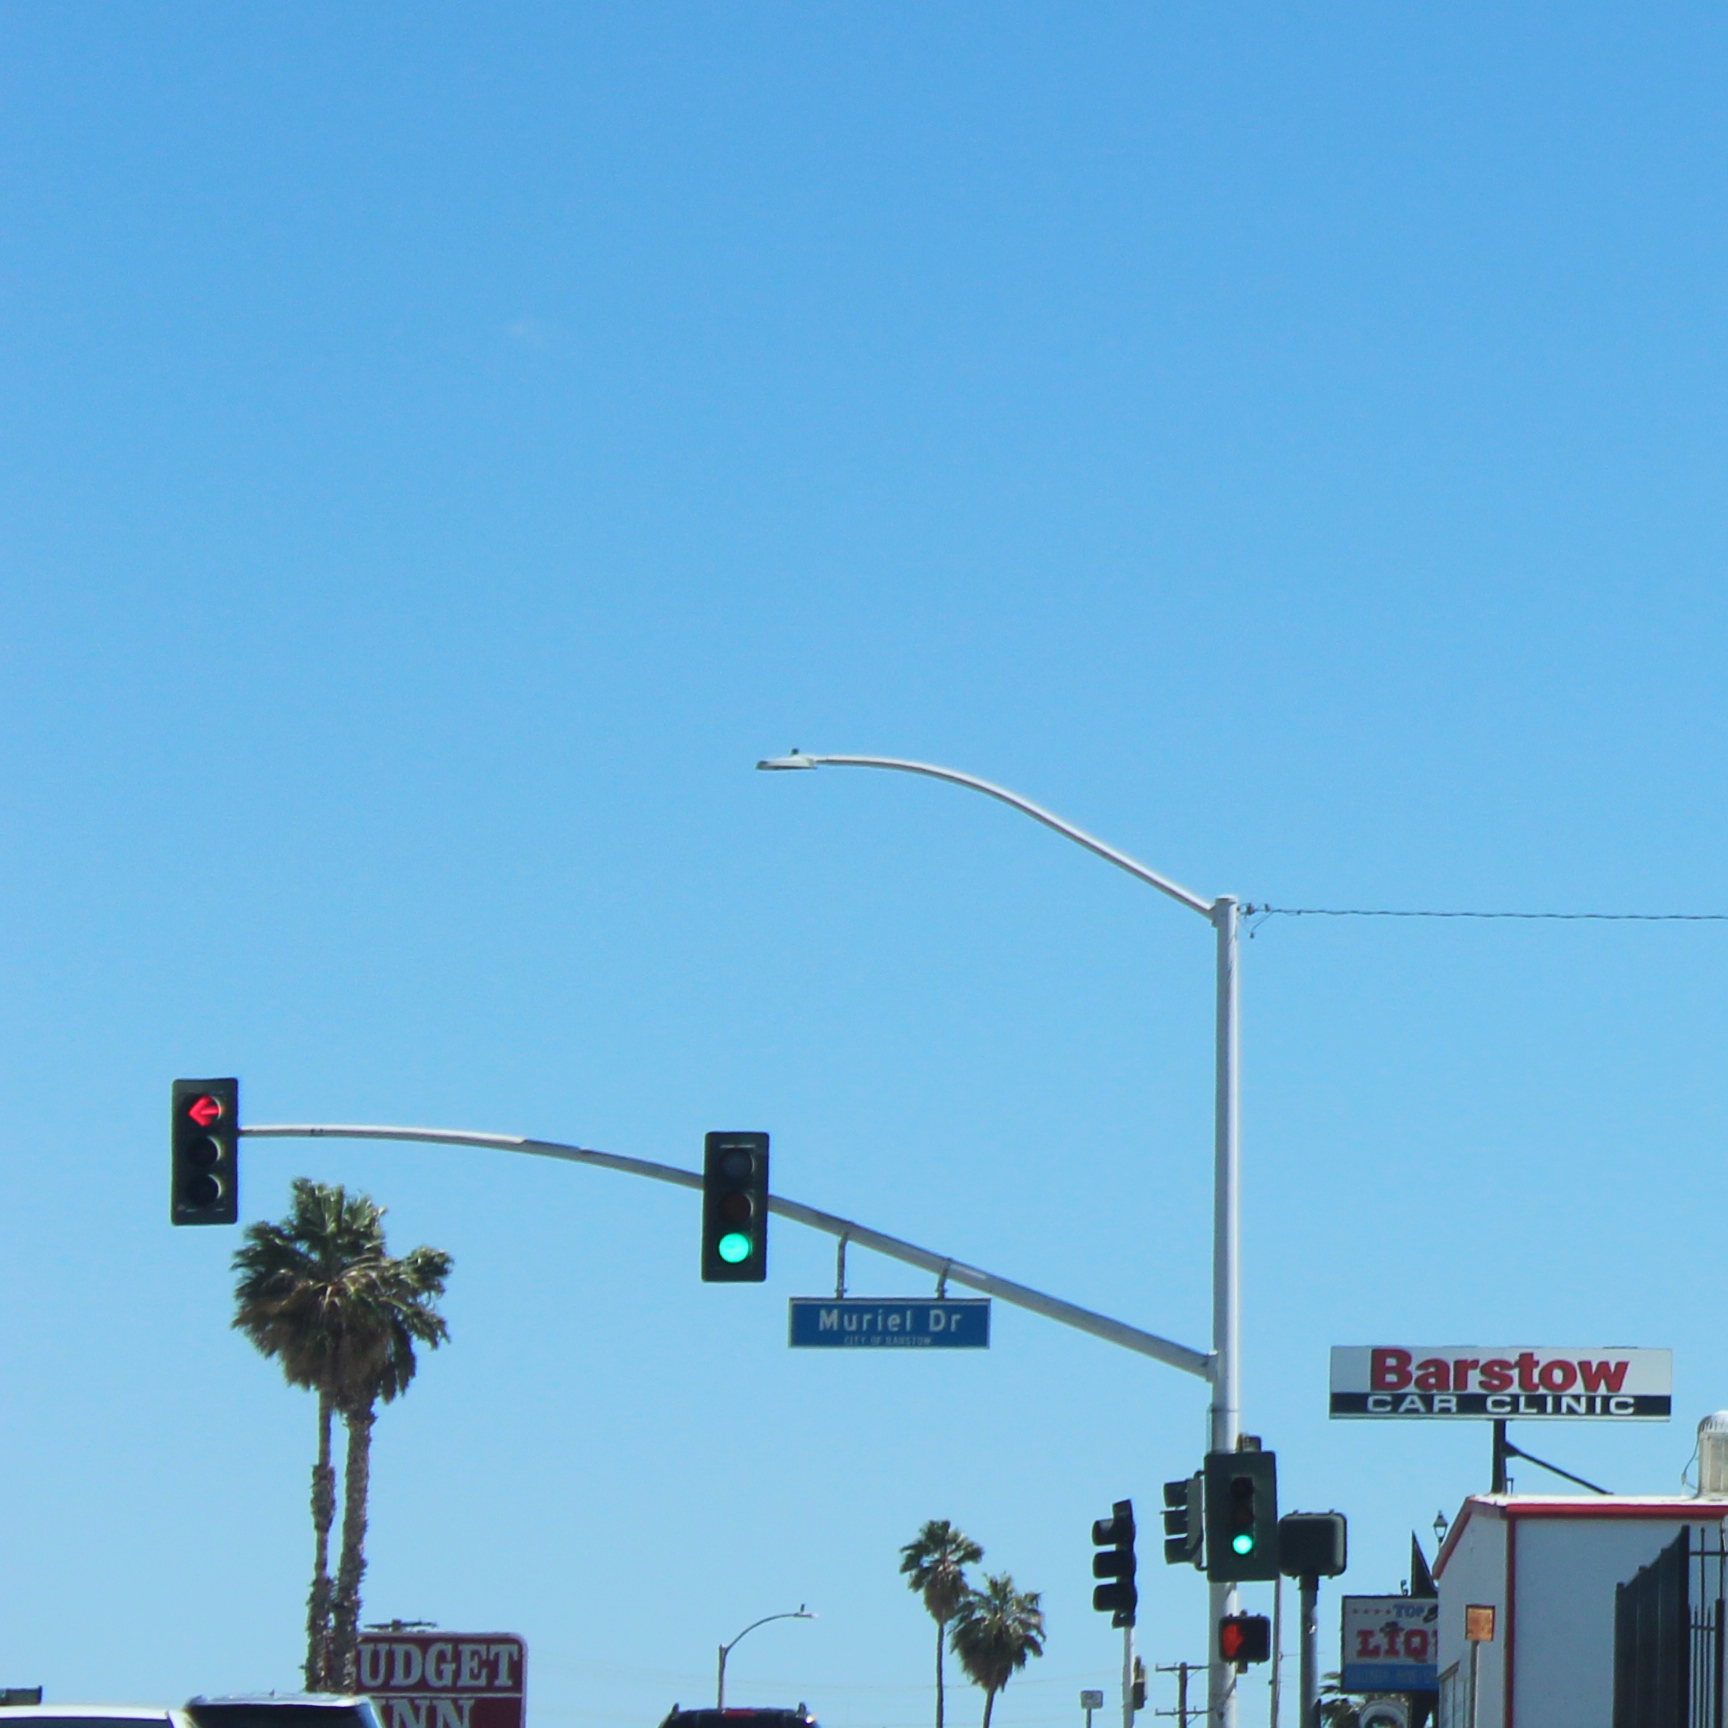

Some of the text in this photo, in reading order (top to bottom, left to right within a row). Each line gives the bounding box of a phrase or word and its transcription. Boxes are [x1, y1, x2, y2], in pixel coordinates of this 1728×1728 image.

[818, 1308, 963, 1332] Muriel Dr
[1370, 1348, 1630, 1394] Barstow
[1366, 1395, 1635, 1415] CAR CLINIC
[1356, 1628, 1438, 1664] LIQ
[357, 1642, 519, 1688] UDGET
